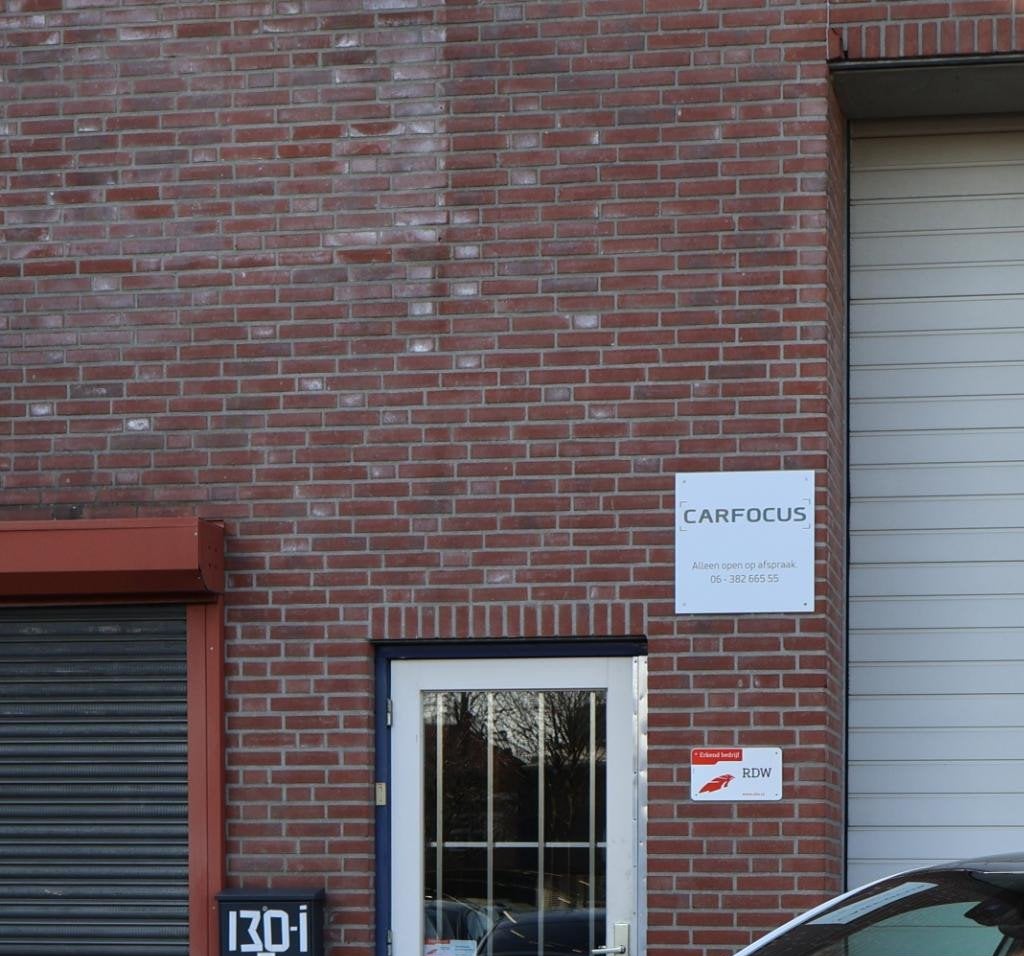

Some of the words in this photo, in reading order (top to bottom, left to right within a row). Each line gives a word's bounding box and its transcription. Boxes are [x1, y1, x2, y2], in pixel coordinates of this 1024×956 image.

[683, 506, 807, 524] CARFOCUS
[692, 561, 720, 570] Alleen
[721, 562, 743, 571] open
[744, 561, 756, 571] op
[710, 574, 722, 584] 06
[729, 574, 747, 584] 382
[748, 573, 766, 583] 665
[767, 573, 780, 583] 55
[742, 767, 772, 778] RDW
